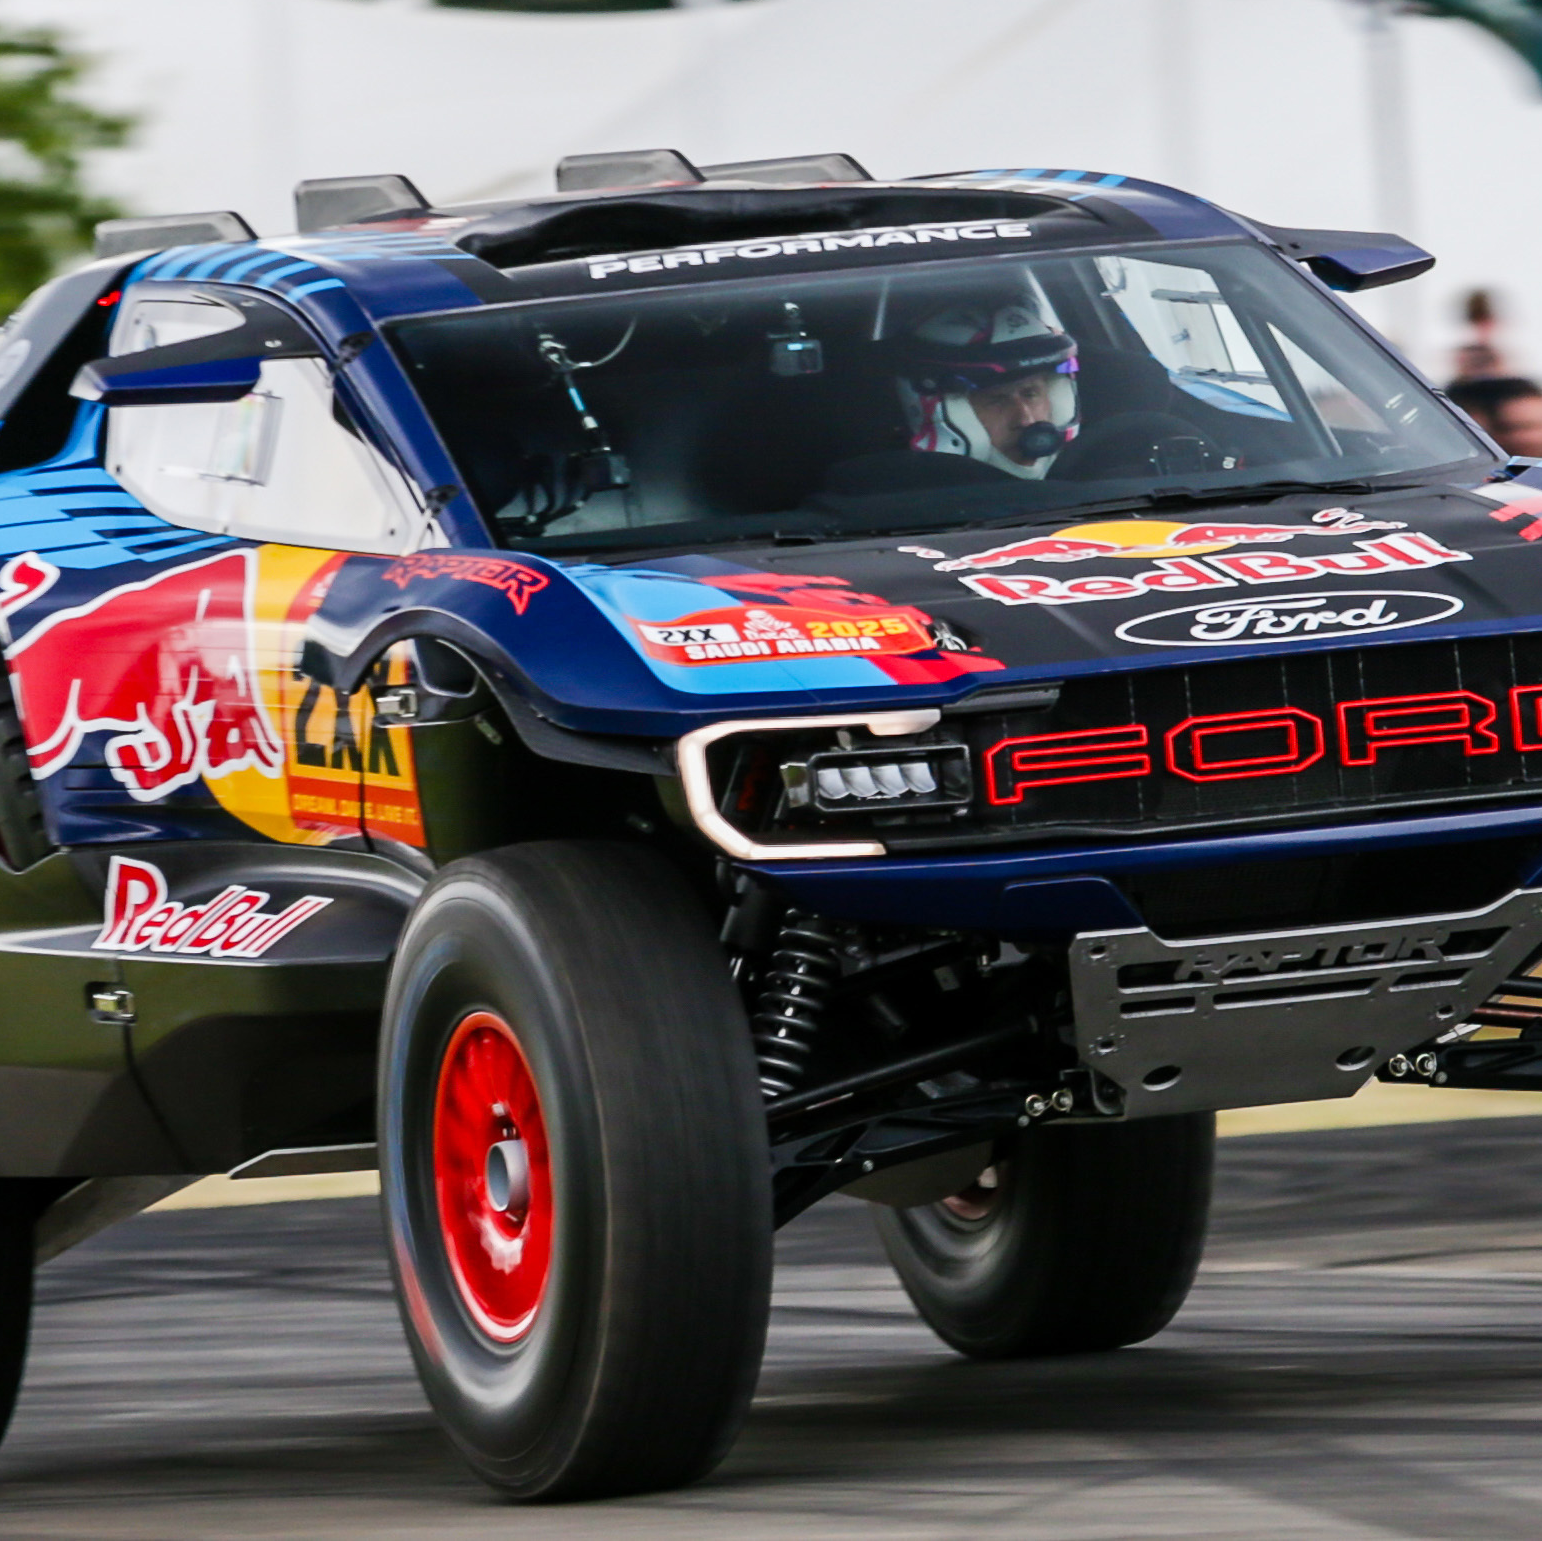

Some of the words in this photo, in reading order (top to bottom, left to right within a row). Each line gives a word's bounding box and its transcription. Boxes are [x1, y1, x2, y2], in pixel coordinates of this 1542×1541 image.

[587, 221, 1033, 280] PERFORMANCE
[381, 553, 551, 616] RAPTOR
[959, 556, 1238, 605] Red
[1208, 532, 1472, 585] Bull
[806, 617, 909, 639] 2025
[1189, 596, 1399, 641] Ford
[684, 640, 771, 661] SAUDI
[776, 636, 881, 654] ARABIA
[90, 855, 248, 952] Red
[175, 890, 335, 958] Bull
[1171, 929, 1450, 982] RAPTOR
